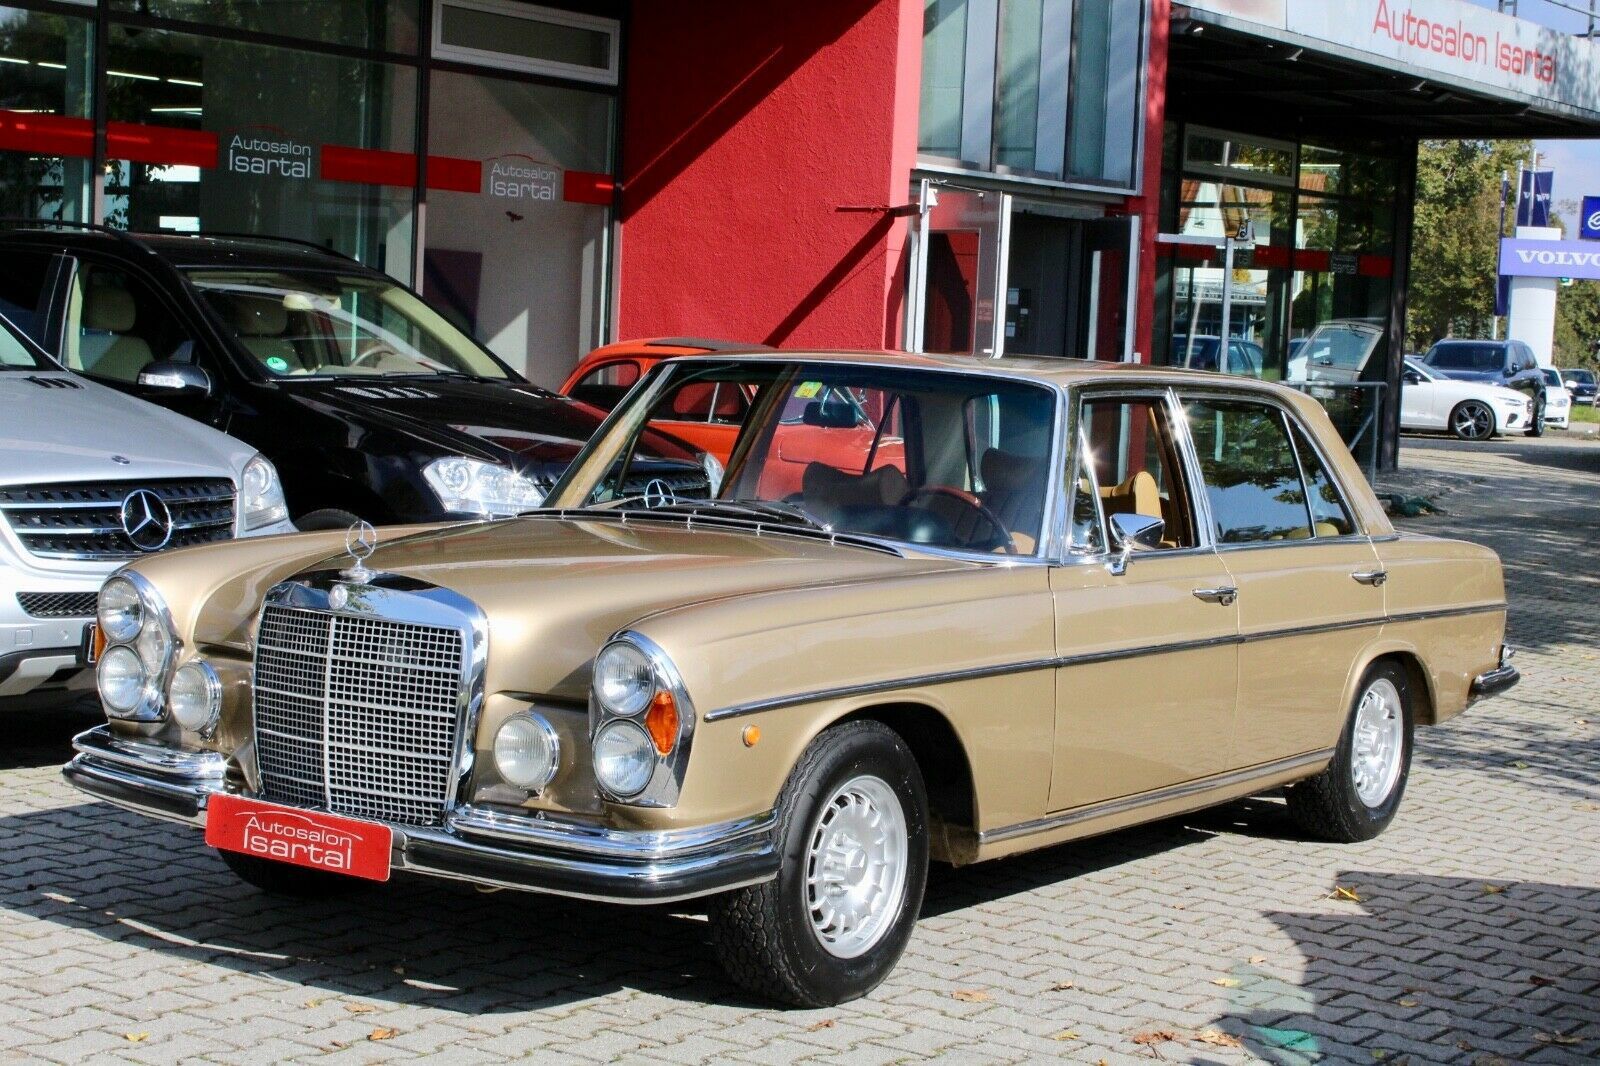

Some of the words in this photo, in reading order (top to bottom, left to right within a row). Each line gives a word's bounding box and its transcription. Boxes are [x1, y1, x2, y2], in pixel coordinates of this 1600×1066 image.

[1373, 0, 1487, 65] Autosalon
[1494, 31, 1556, 84] Isartal
[230, 135, 311, 156] Autosalon
[229, 149, 311, 178] Isartal
[491, 163, 556, 180] Autosalon
[490, 175, 556, 200] Isartal
[246, 816, 352, 847] Autosalon
[243, 827, 352, 870] Isartal
